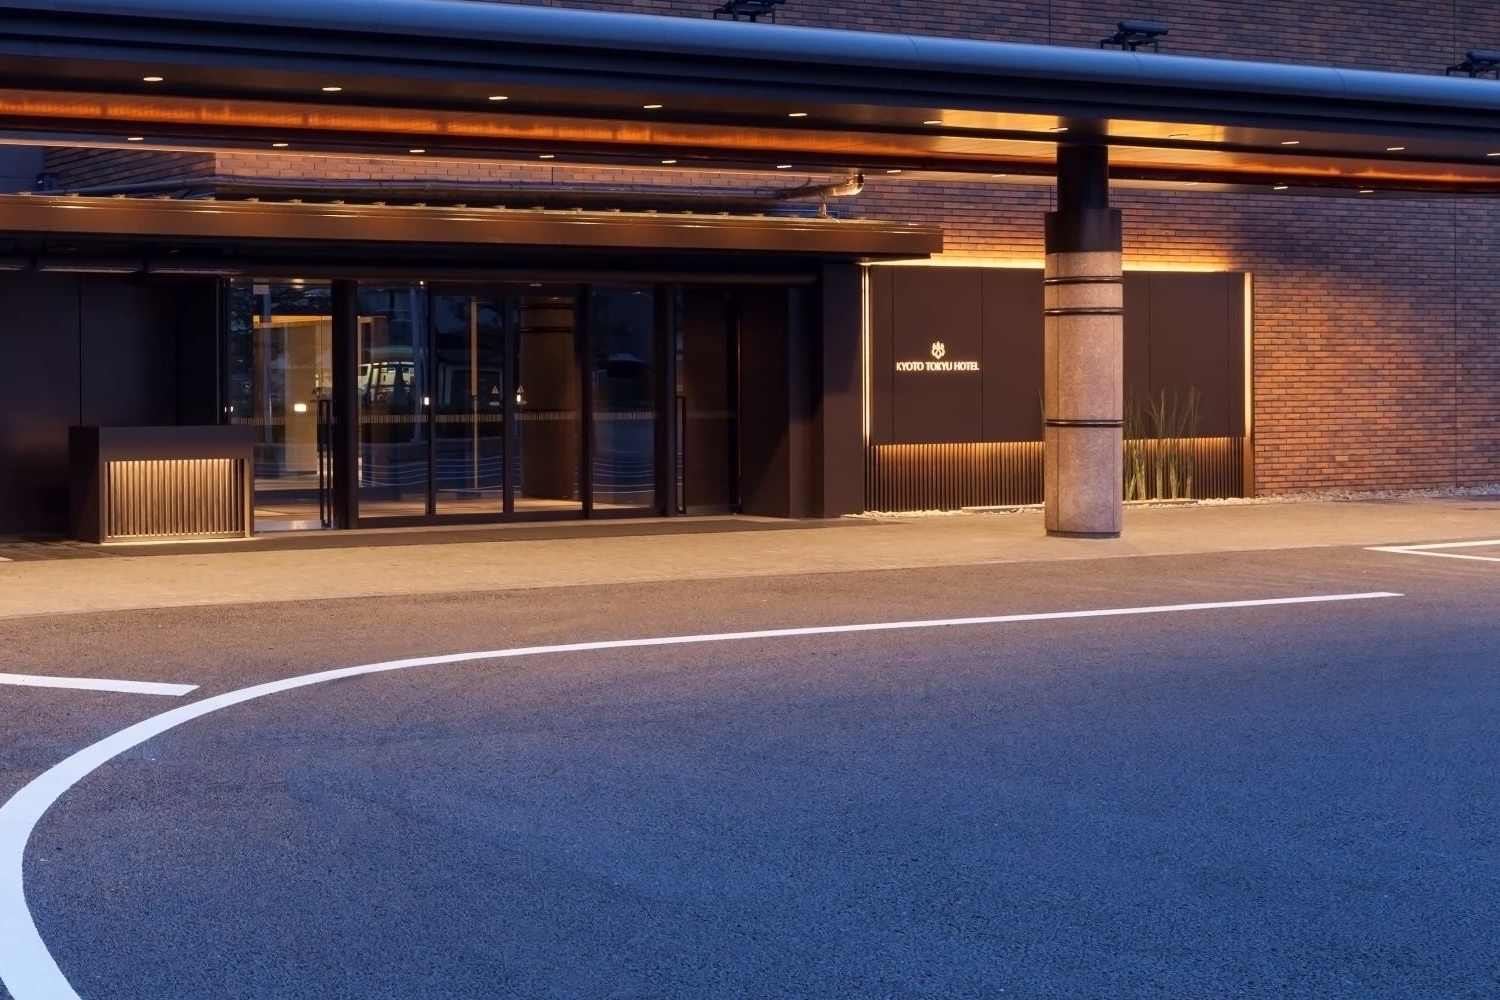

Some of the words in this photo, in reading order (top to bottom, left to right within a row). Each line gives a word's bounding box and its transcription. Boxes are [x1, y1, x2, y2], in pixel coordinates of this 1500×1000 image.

[896, 361, 924, 371] KYOTO
[925, 361, 953, 371] TOKYU
[954, 361, 980, 371] HOTEL
